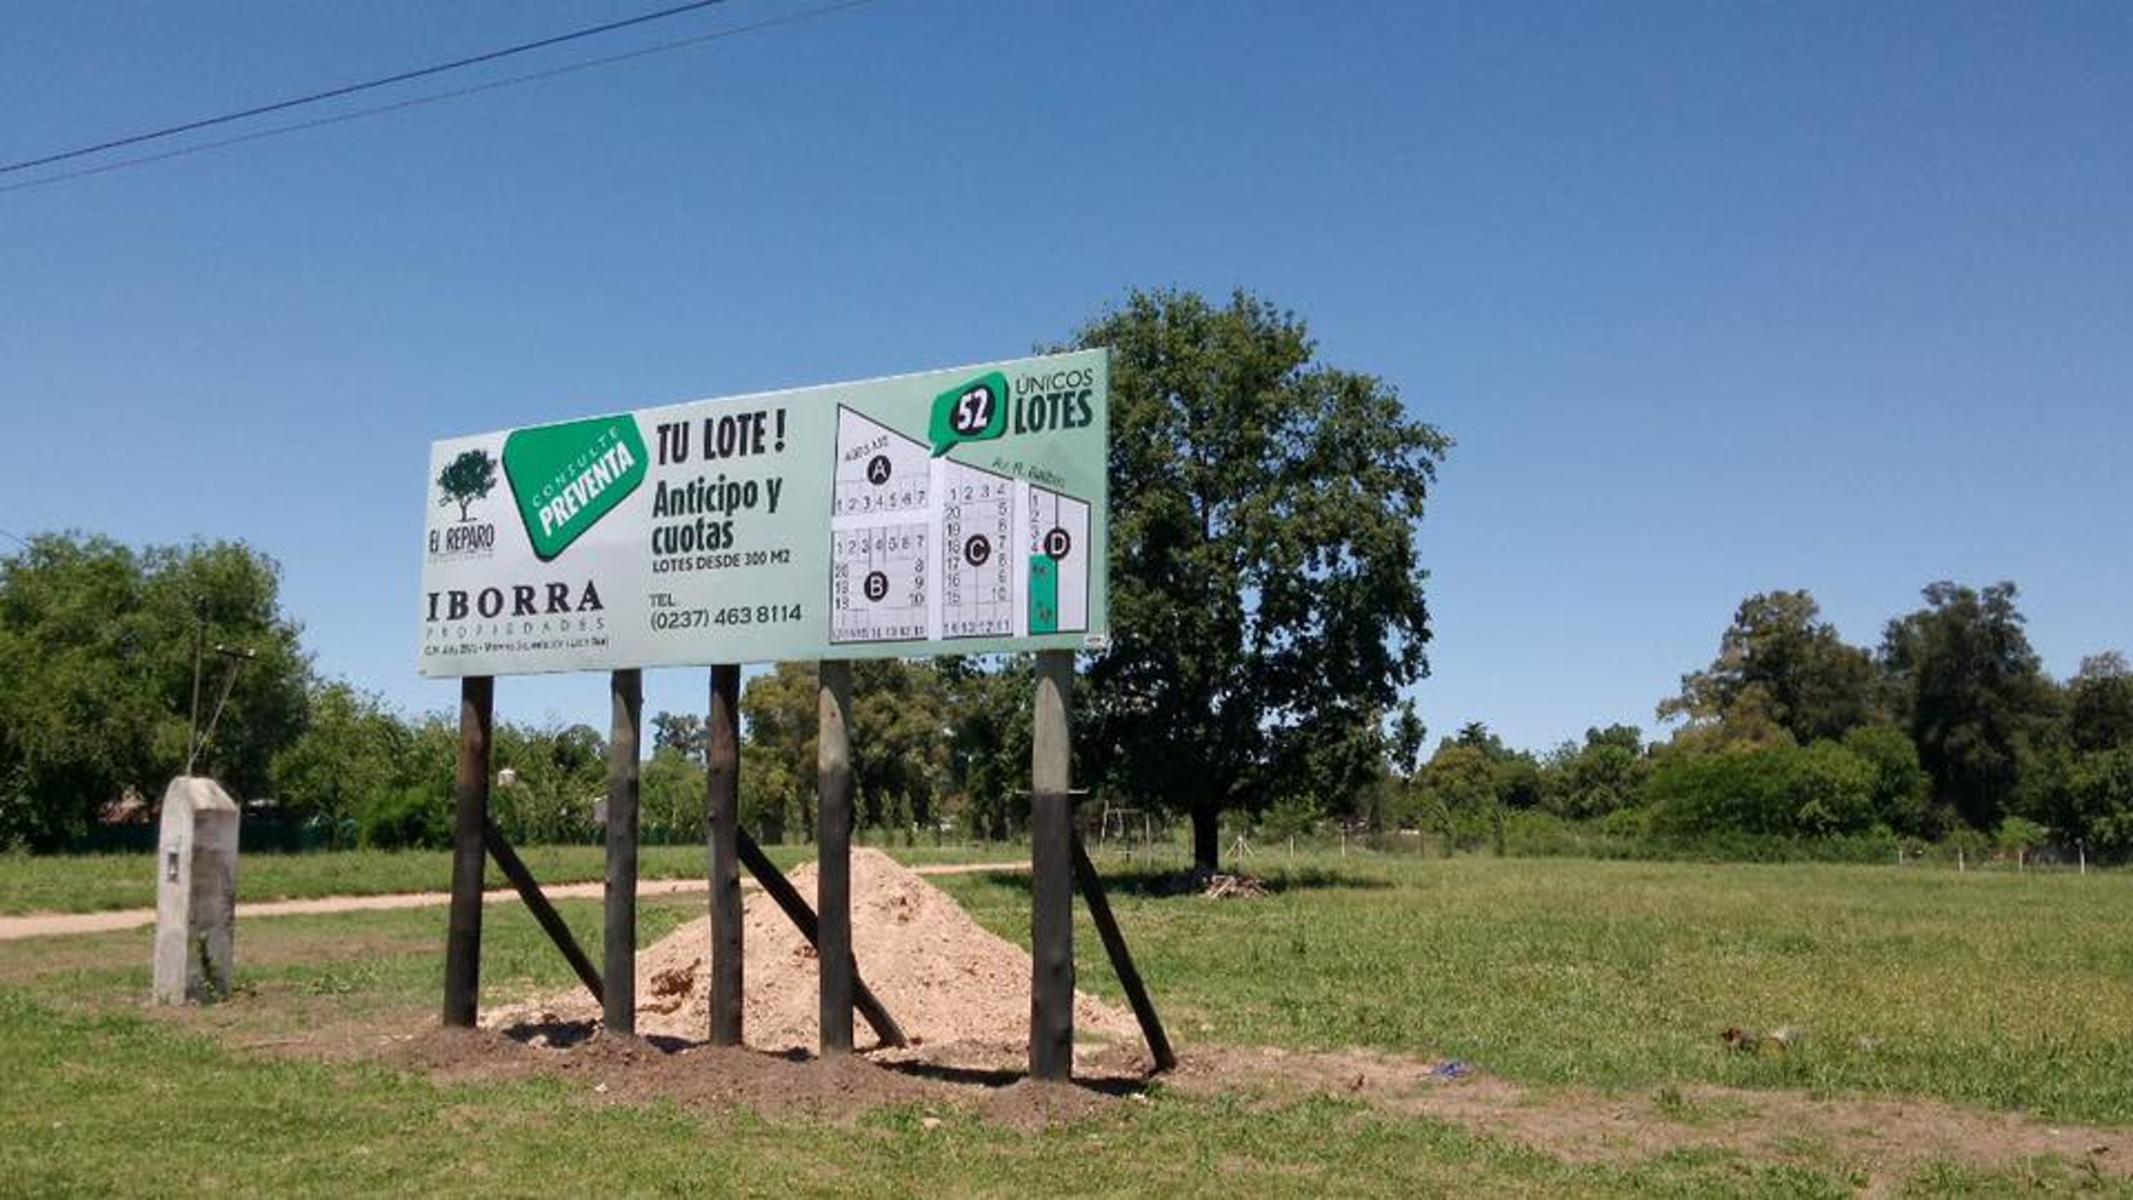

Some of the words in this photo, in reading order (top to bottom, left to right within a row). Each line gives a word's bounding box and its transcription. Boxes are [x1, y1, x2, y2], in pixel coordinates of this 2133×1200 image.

[957, 388, 988, 430] 52
[1015, 389, 1093, 435] LOTES
[657, 421, 690, 465] TU
[532, 426, 619, 507] CONSULTE
[873, 459, 887, 479] A
[538, 441, 636, 537] PREVENTA
[653, 473, 758, 517] Anticipo
[766, 477, 783, 514] y
[964, 486, 973, 500] 2
[446, 524, 495, 552] REPARO
[652, 517, 734, 555] cuotas
[1051, 532, 1067, 555] D
[652, 557, 694, 573] LOTES
[696, 553, 741, 570] DESDE
[744, 551, 767, 566] 300
[770, 549, 791, 564] M2
[970, 539, 985, 562] C
[870, 575, 883, 597] B
[426, 579, 605, 622] IBORRA
[426, 617, 606, 639] PROPIEDADES
[650, 608, 710, 632] (0237)
[714, 606, 752, 626] 463
[756, 604, 802, 624] 8114
